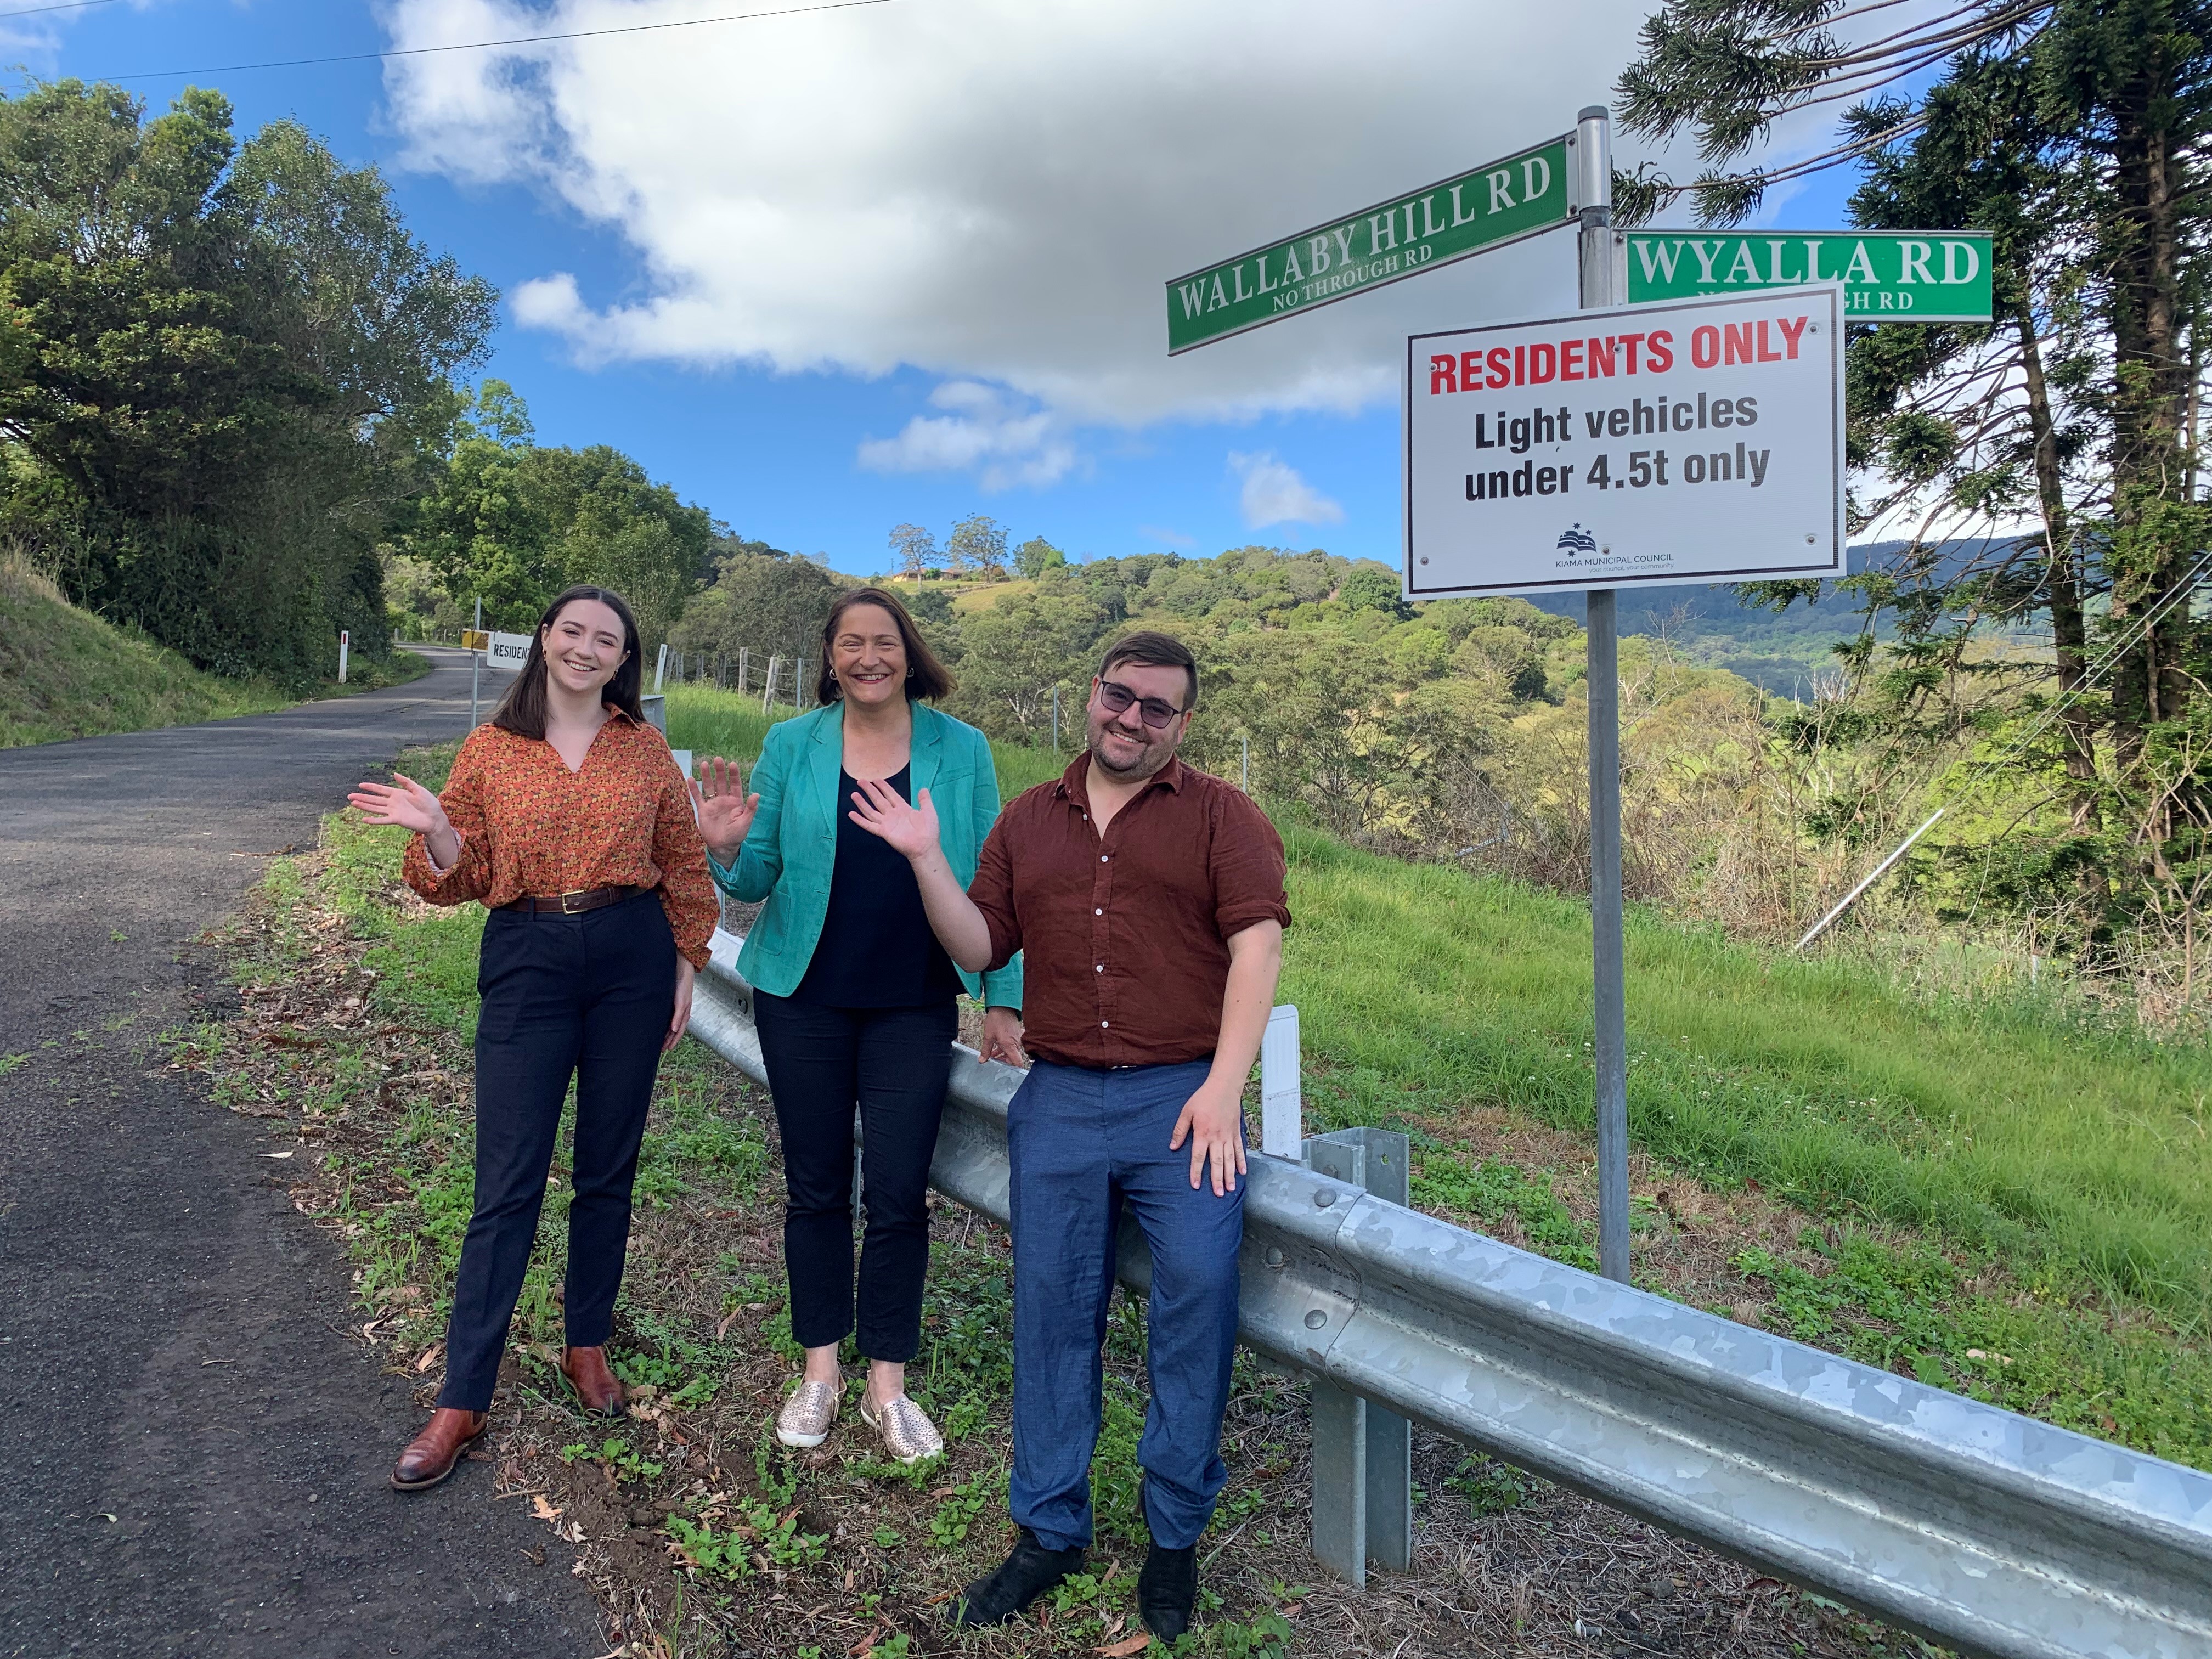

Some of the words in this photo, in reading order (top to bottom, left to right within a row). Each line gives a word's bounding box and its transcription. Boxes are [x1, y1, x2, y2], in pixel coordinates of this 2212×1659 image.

[1178, 224, 1356, 320] WALLABY
[1368, 184, 1475, 256] HILL
[1486, 157, 1550, 215] RD
[1632, 240, 1880, 284] WYALLA
[1897, 241, 1979, 284] RD
[1272, 290, 1299, 313] NO
[1302, 255, 1399, 301] THROUGH
[1404, 245, 1432, 268] RD
[1878, 292, 1914, 309] RD
[1431, 330, 1673, 394] RESIDENTS
[1691, 316, 1809, 369] ONLY
[1476, 406, 1571, 454] Light
[1584, 392, 1758, 439] vehicles
[1465, 460, 1573, 501] under
[1587, 450, 1668, 490] 4.5t
[1684, 442, 1770, 488] only
[1555, 560, 1583, 568] KIAMA
[1585, 556, 1632, 566] MUNICIPAL
[1634, 554, 1674, 562] COUNCIL
[494, 644, 530, 659] RESIDEN
